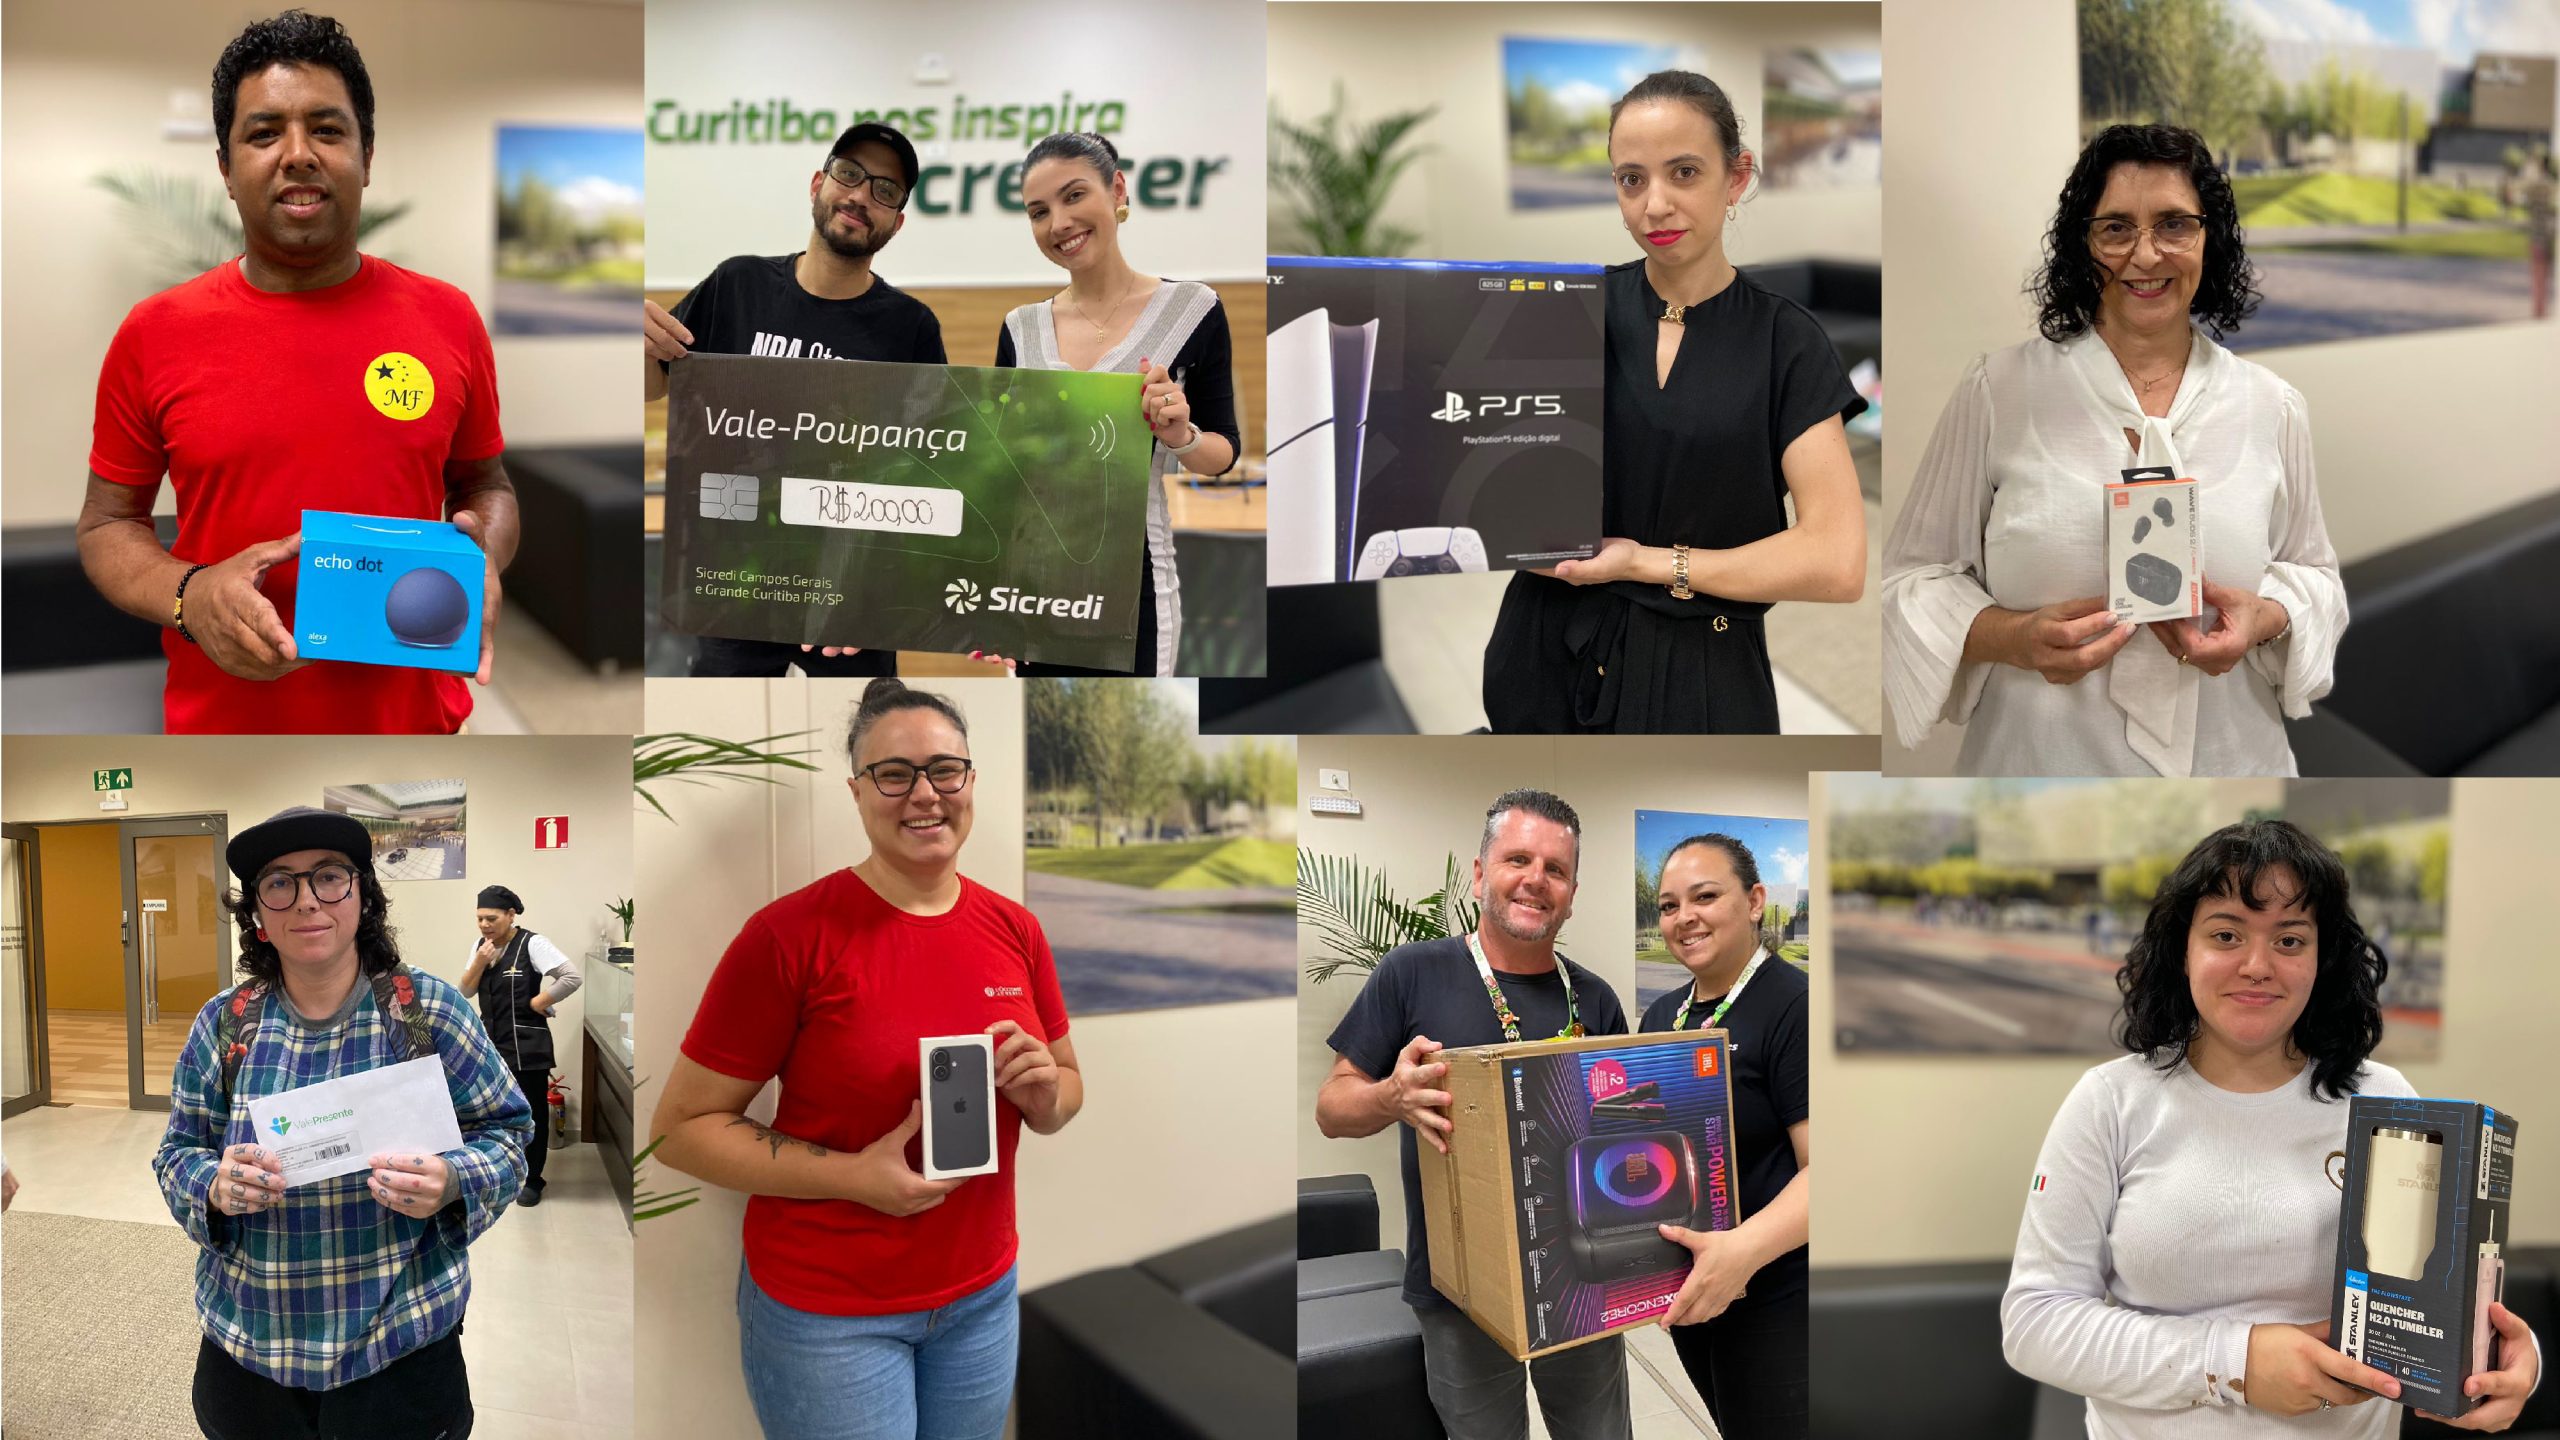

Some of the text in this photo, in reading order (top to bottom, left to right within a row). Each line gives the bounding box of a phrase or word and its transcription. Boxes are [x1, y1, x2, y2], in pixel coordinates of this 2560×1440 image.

[649, 98, 836, 144] Curitiba
[951, 91, 1126, 147] inspira
[383, 389, 423, 411] MF
[1479, 395, 1561, 416] PS5
[705, 406, 968, 459] Vale-Poupança
[314, 553, 383, 573] echo dot
[695, 566, 832, 589] Sicredi Campos Gerais
[695, 583, 844, 607] e Grande Curitiba PR/SP
[988, 586, 1105, 621] Sicredi
[308, 632, 328, 641] alexa
[1702, 1053, 1713, 1072] JBL
[1704, 1117, 1717, 1147] STAR
[2481, 1130, 2490, 1178] STANLEY
[1626, 1152, 1648, 1182] JBL
[1706, 1145, 1727, 1209] POWER
[2349, 1293, 2360, 1346] STANLEY
[2369, 1300, 2425, 1322] QUENCHER
[2369, 1312, 2444, 1339] H2.0 TUMBLER
[2401, 1366, 2410, 1376] 40
